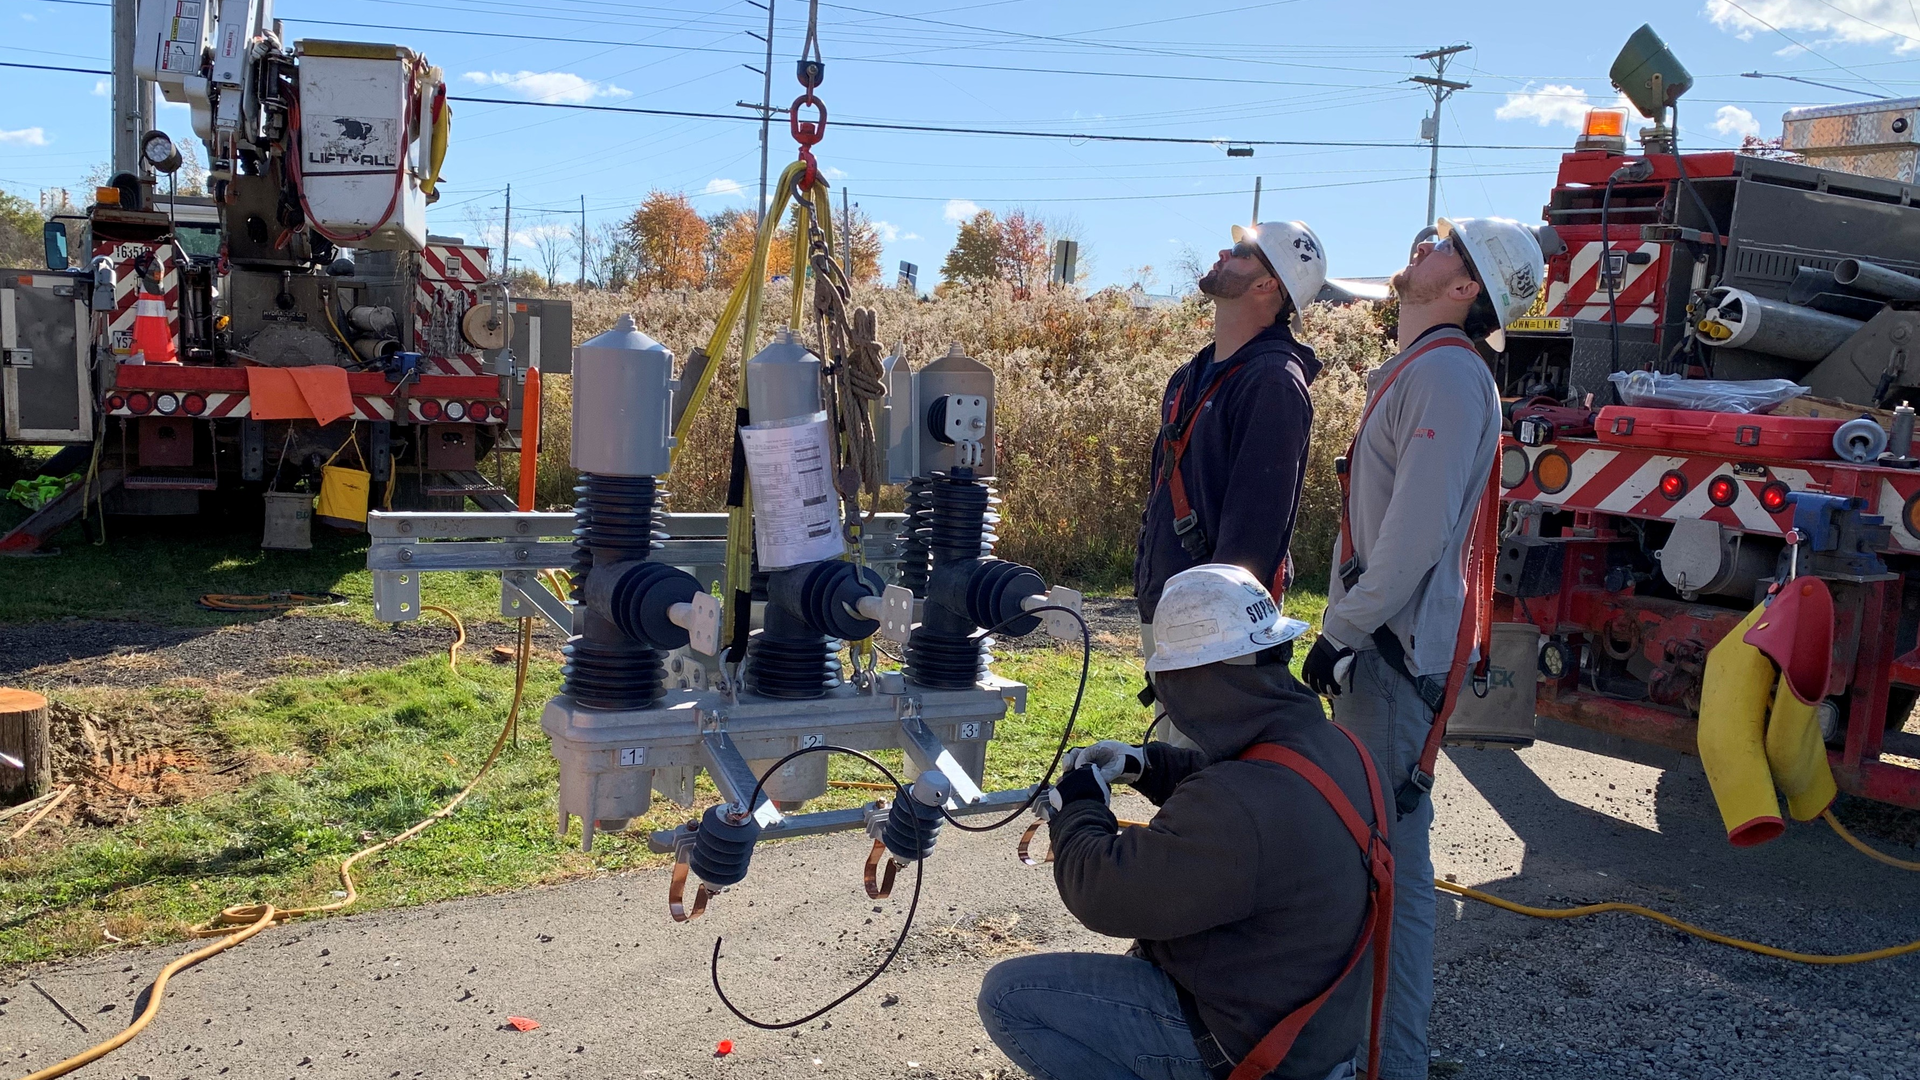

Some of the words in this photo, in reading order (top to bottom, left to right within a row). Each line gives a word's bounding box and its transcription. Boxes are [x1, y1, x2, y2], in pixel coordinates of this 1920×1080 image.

[361, 154, 396, 167] ALL
[966, 723, 974, 738] 3
[809, 735, 817, 748] 2
[629, 749, 636, 765] 1
